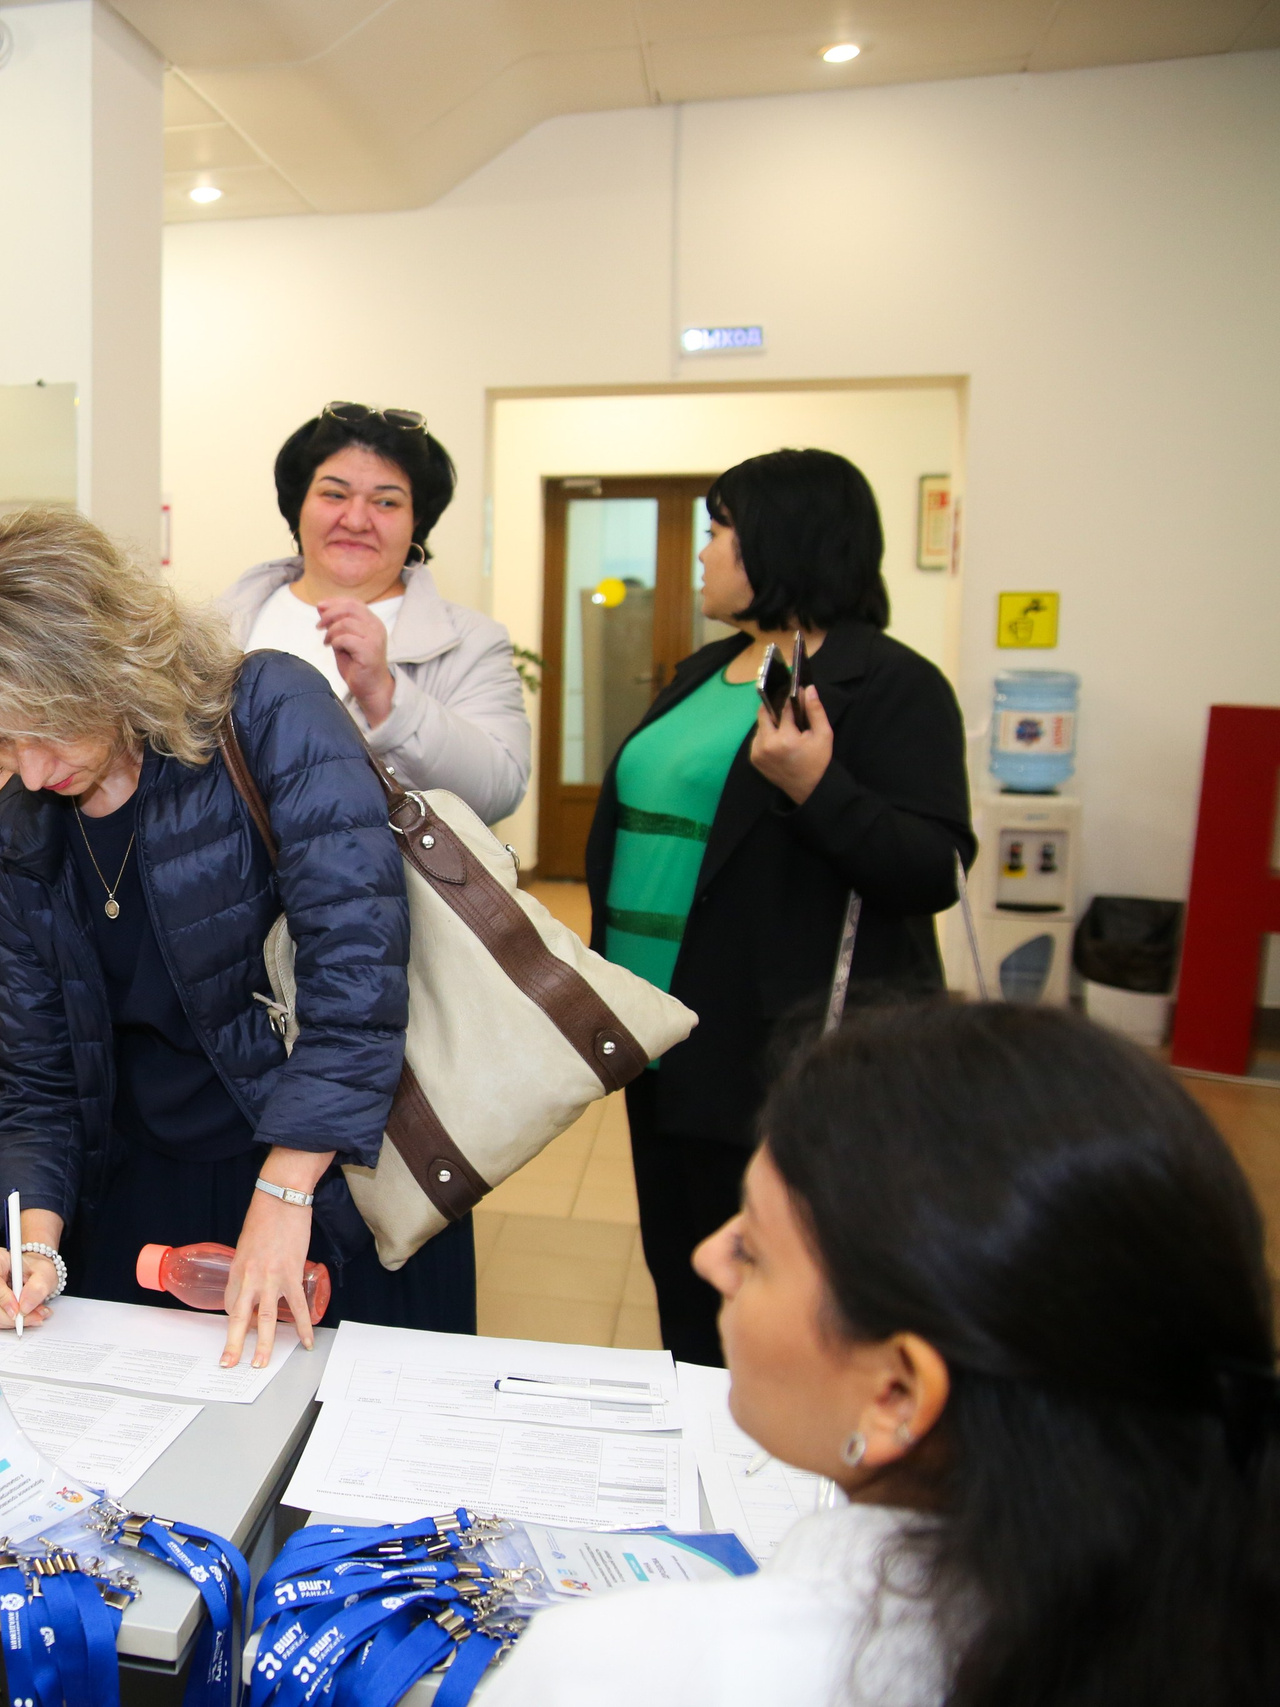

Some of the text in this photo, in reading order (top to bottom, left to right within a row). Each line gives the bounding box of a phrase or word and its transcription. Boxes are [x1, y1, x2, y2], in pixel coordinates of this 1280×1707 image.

[683, 328, 762, 351] ЫХОД
[297, 1580, 331, 1592] ВШГУ
[301, 1589, 335, 1598] РАНХиГС
[6, 1612, 18, 1650] АКАДЕМИЯ
[273, 1622, 302, 1655] ВШГУ
[308, 1626, 339, 1658] ВШГУ
[282, 1632, 309, 1660] РАНХиГС
[316, 1632, 346, 1663] РАНХиГС
